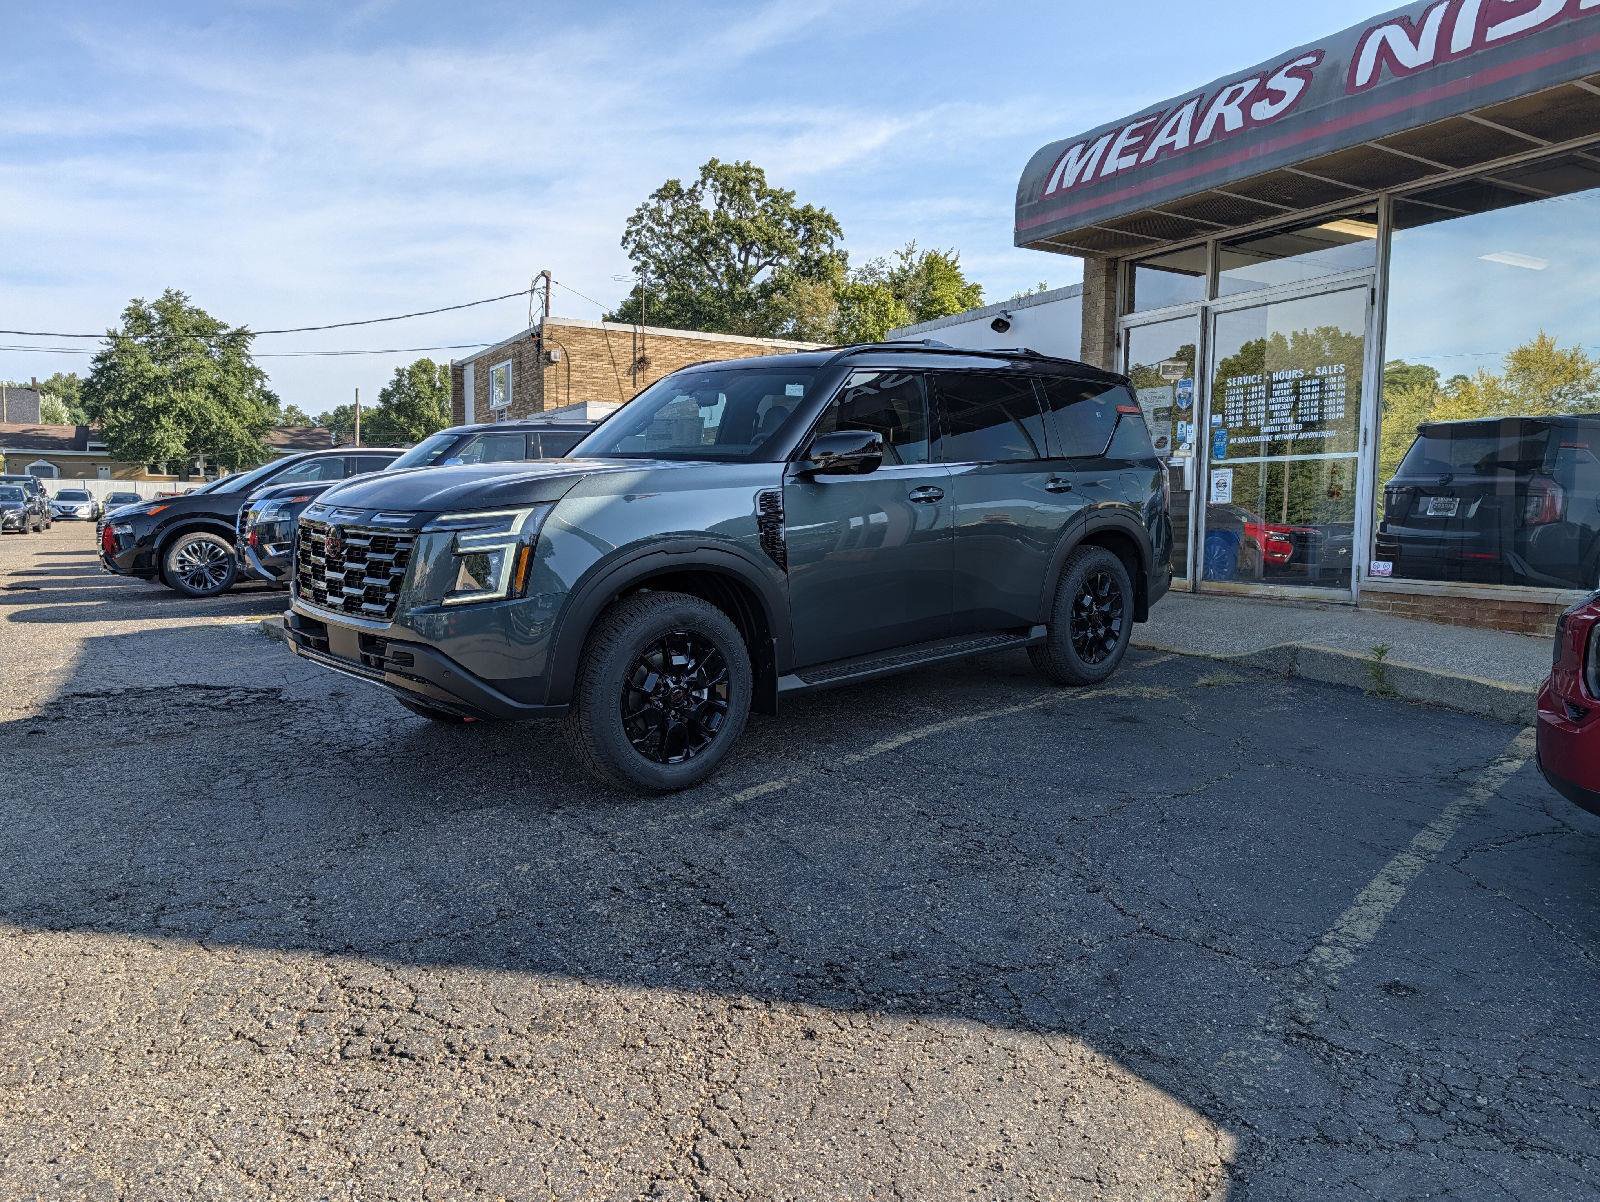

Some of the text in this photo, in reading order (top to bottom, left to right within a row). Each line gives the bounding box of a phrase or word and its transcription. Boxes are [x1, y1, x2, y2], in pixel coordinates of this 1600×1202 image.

[1043, 0, 1600, 198] MEARS NIS
[1226, 364, 1345, 387] SERVICE HOURS SALES
[1260, 423, 1303, 433] SUNDAY CLOSED
